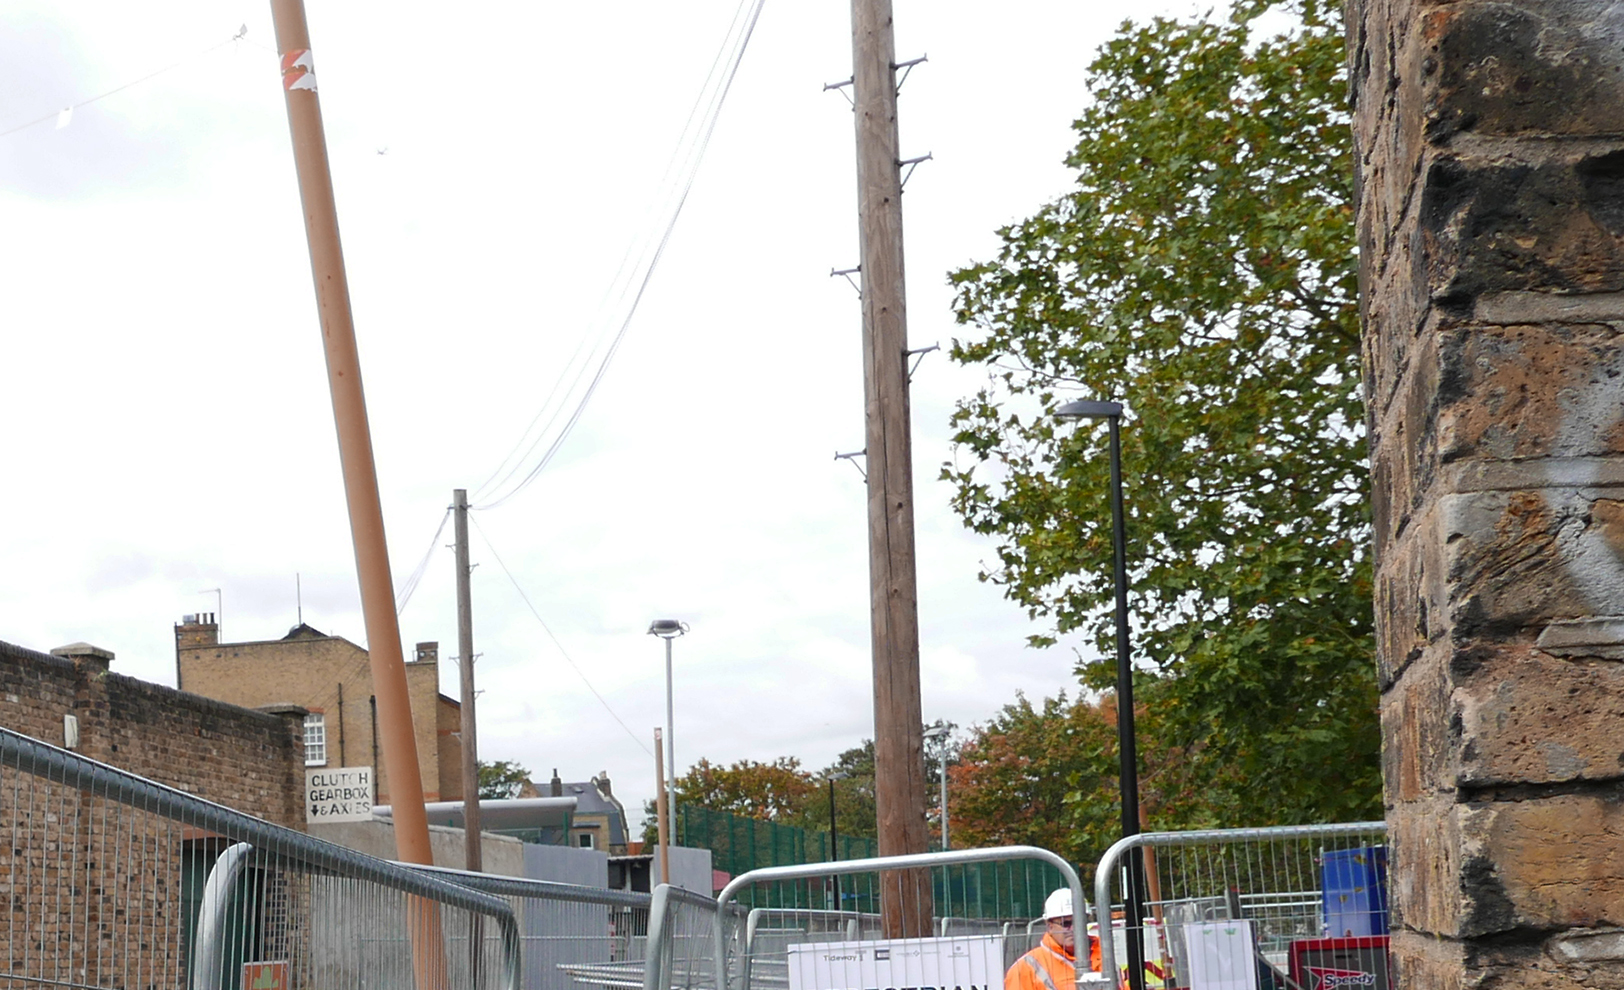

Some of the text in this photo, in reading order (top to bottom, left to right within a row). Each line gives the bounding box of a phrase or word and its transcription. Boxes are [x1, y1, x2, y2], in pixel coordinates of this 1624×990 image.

[311, 772, 369, 787] CLUTCH
[309, 787, 370, 802] GEARBOX
[823, 954, 858, 962] Tideway
[1324, 973, 1376, 986] Speedy
